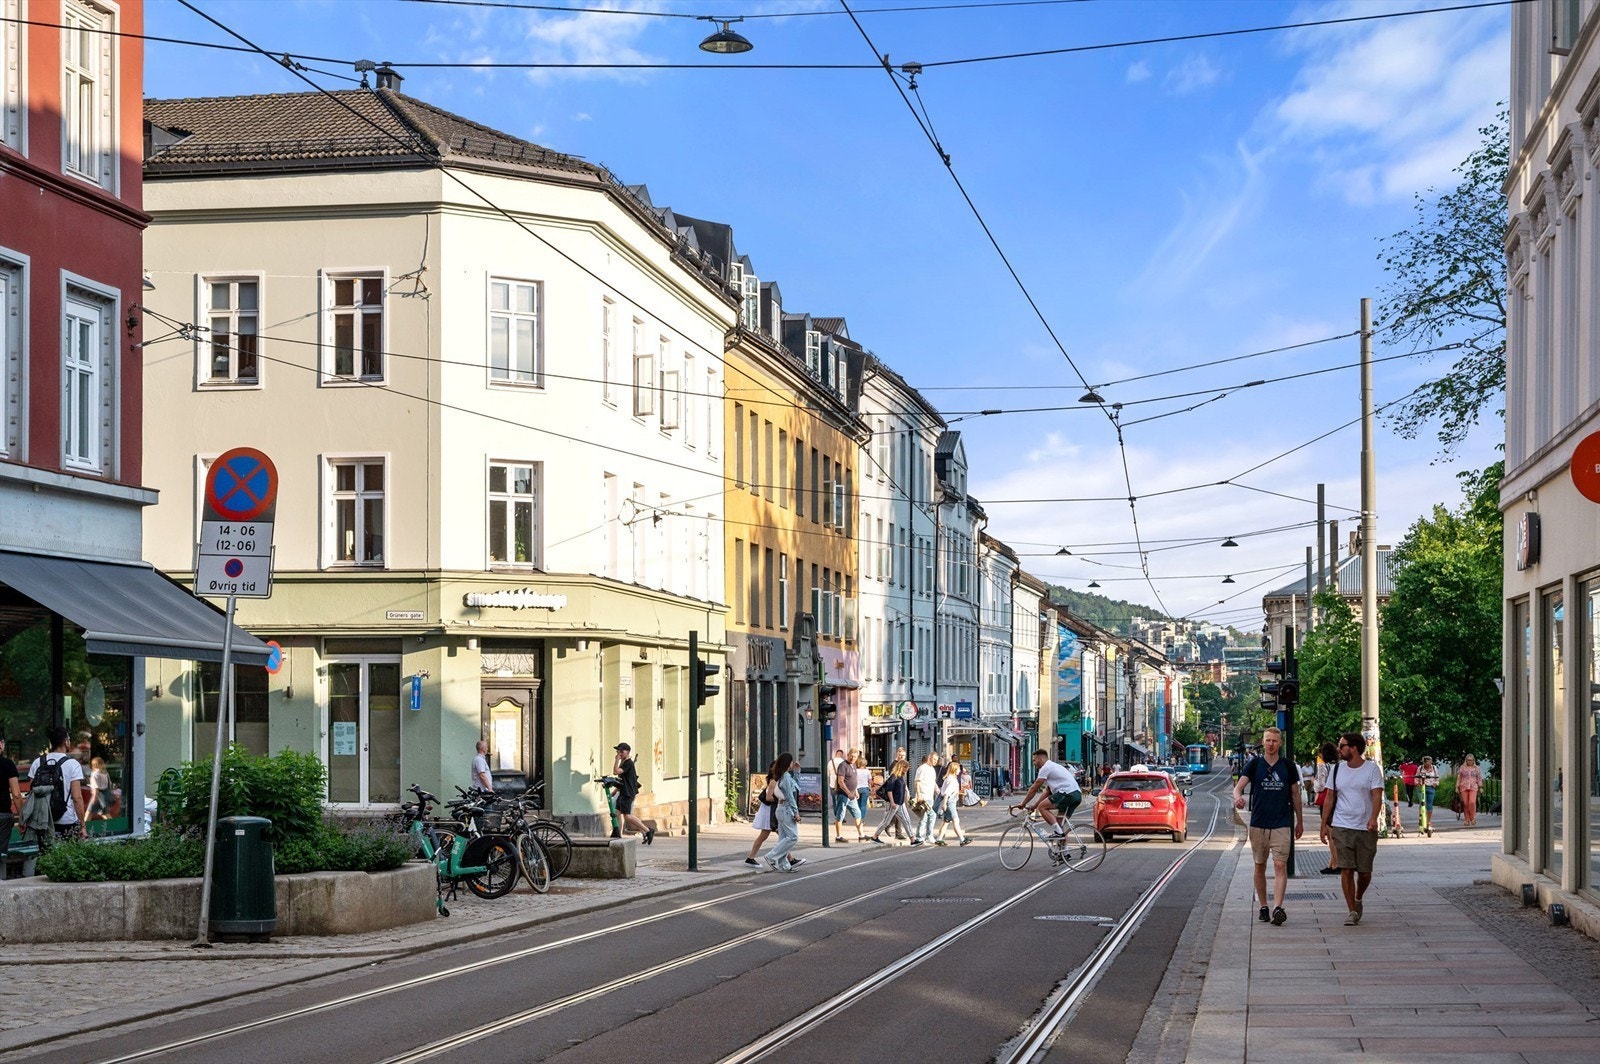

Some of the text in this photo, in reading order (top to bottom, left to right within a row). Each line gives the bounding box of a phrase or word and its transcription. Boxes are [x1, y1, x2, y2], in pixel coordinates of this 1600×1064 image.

[220, 526, 230, 535] 14
[240, 526, 255, 536] 06
[216, 540, 256, 552] (12-06)
[209, 580, 256, 593] Øvrig tid
[452, 841, 461, 855] Bolt
